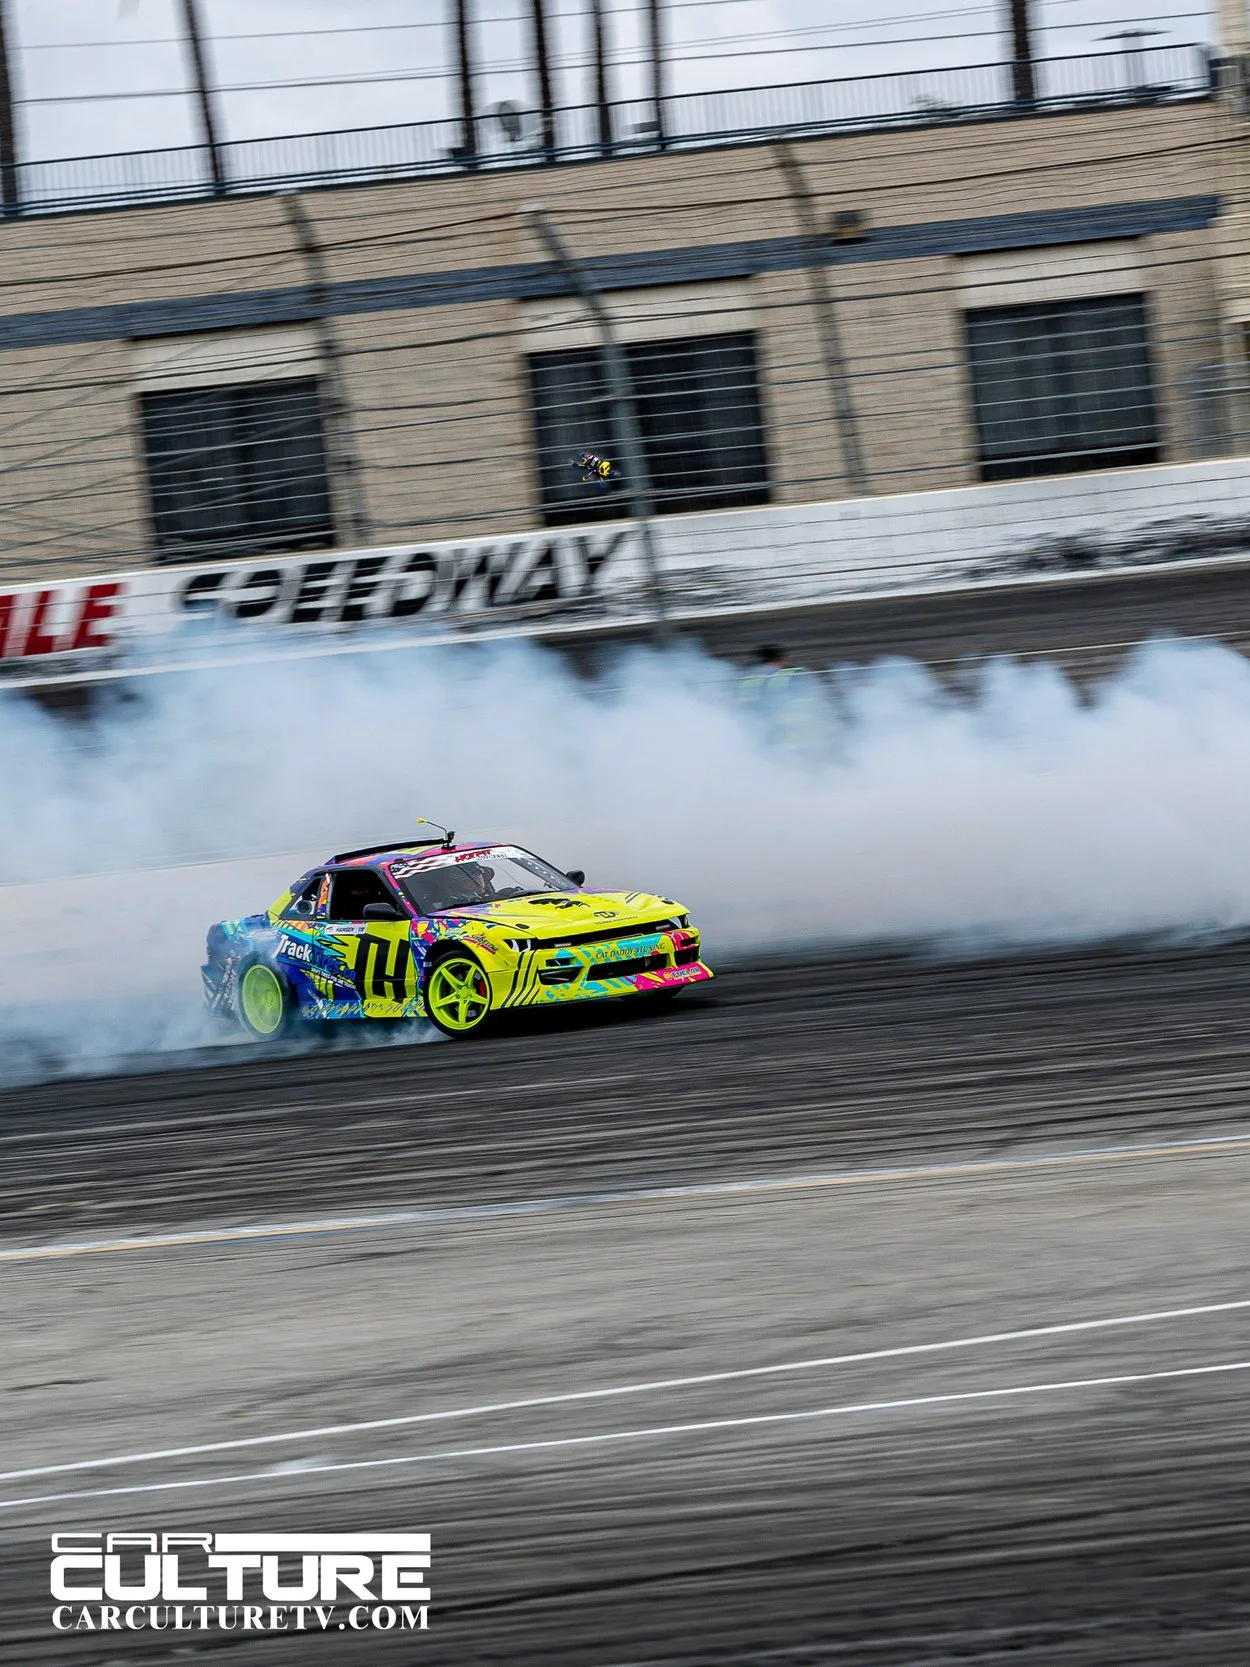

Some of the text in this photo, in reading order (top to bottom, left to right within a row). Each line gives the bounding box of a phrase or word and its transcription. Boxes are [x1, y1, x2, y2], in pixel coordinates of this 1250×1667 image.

[180, 529, 638, 624] SPEEDWAY
[595, 942, 666, 960] CAT DADDY TUNING
